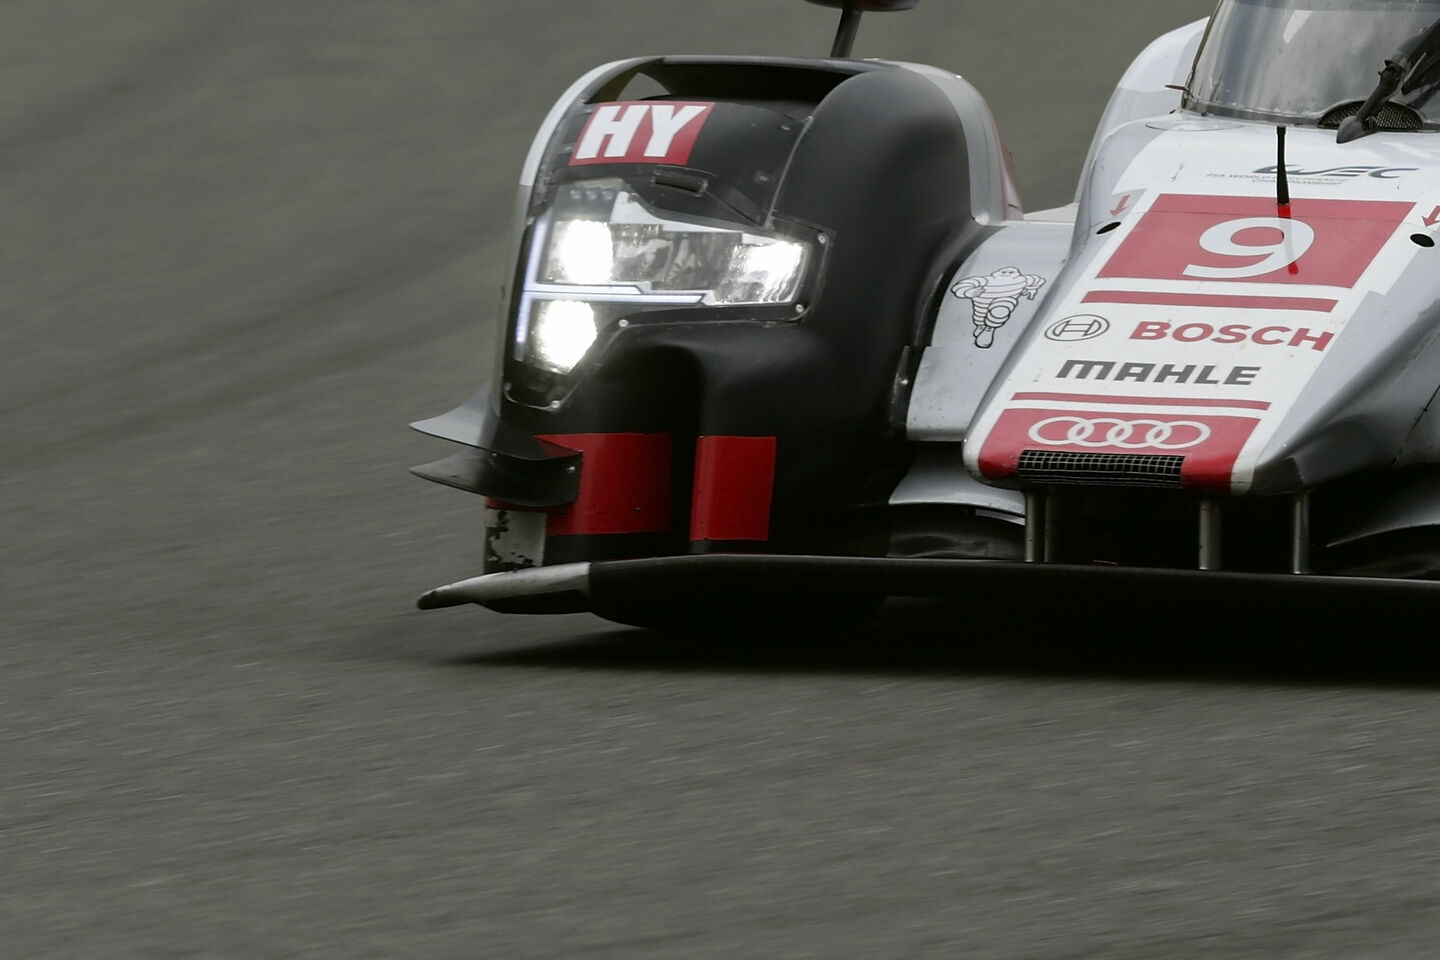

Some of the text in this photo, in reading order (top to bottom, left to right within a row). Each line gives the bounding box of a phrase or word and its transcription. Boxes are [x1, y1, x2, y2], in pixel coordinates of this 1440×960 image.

[575, 104, 708, 160] HY
[1182, 216, 1315, 279] 9
[1129, 321, 1335, 352] BOSCH
[1055, 359, 1262, 386] MAHLE
